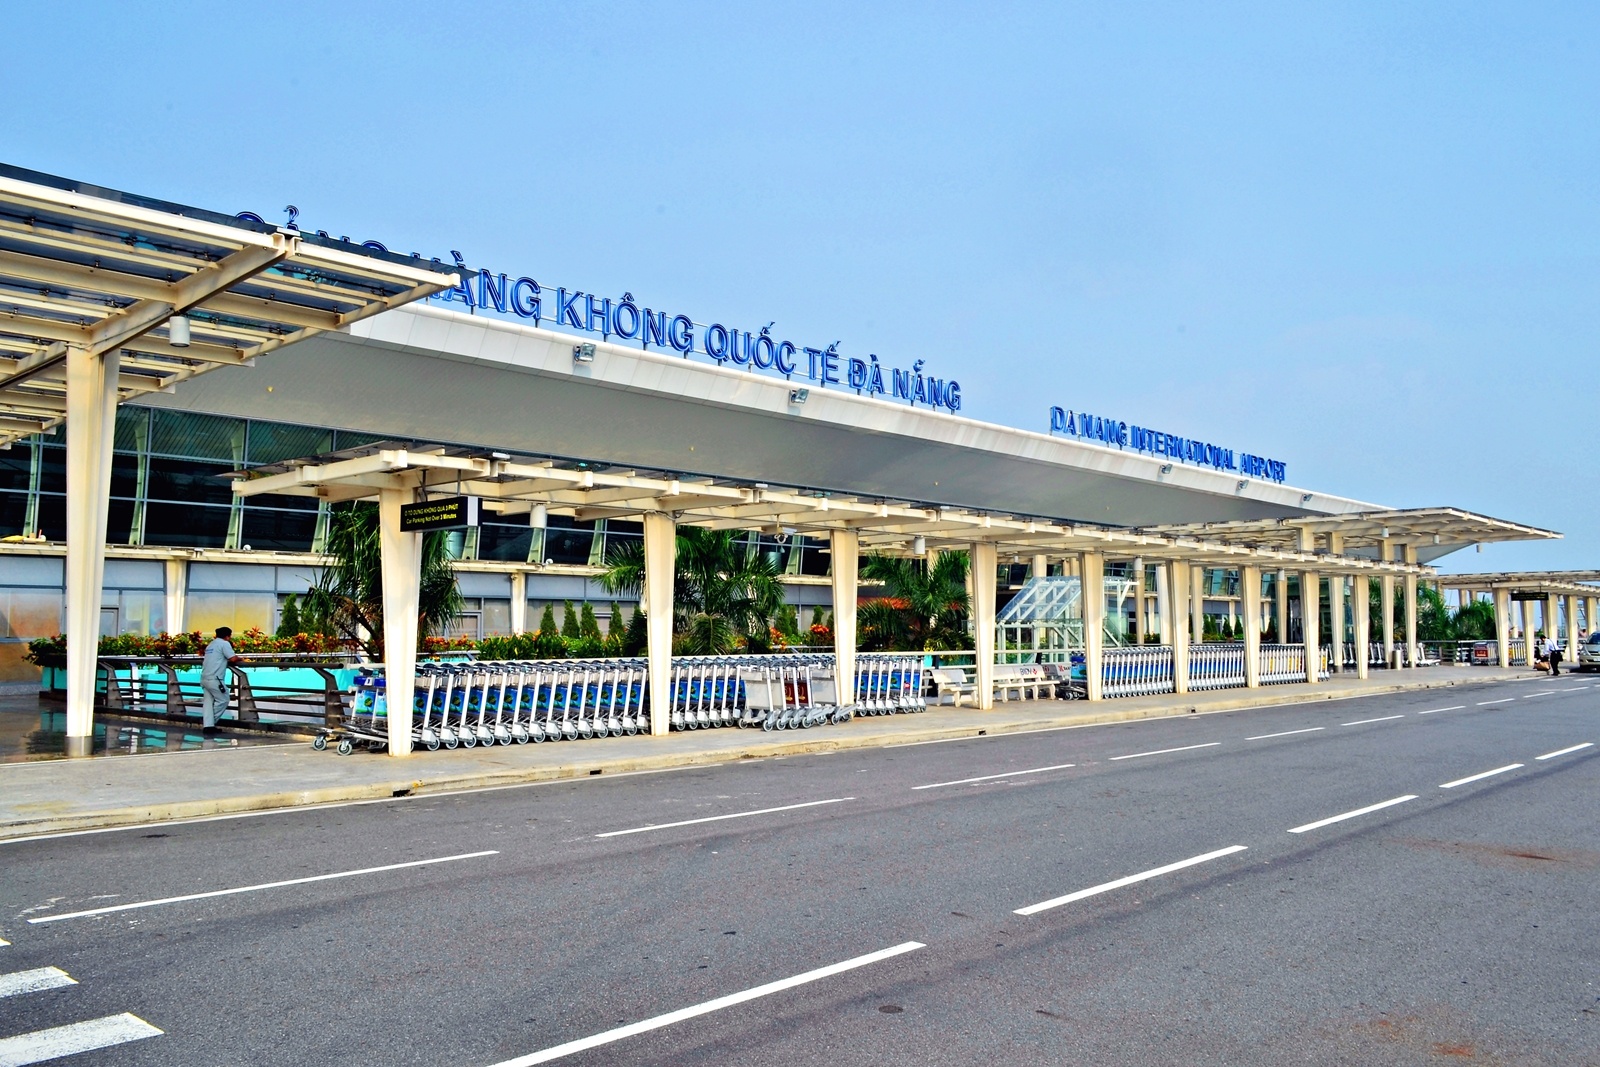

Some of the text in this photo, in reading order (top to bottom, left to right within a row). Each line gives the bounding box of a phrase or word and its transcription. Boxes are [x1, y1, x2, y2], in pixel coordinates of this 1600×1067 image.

[411, 249, 542, 320] ÀNG
[556, 286, 694, 352] KHÔNG
[704, 321, 797, 375] QUỐC
[803, 340, 842, 384] TẾ
[848, 353, 885, 395] ĐÀ
[1050, 405, 1287, 482] DA NANG INTERNATIONAL AIRPORT
[412, 516, 425, 524] Parking
